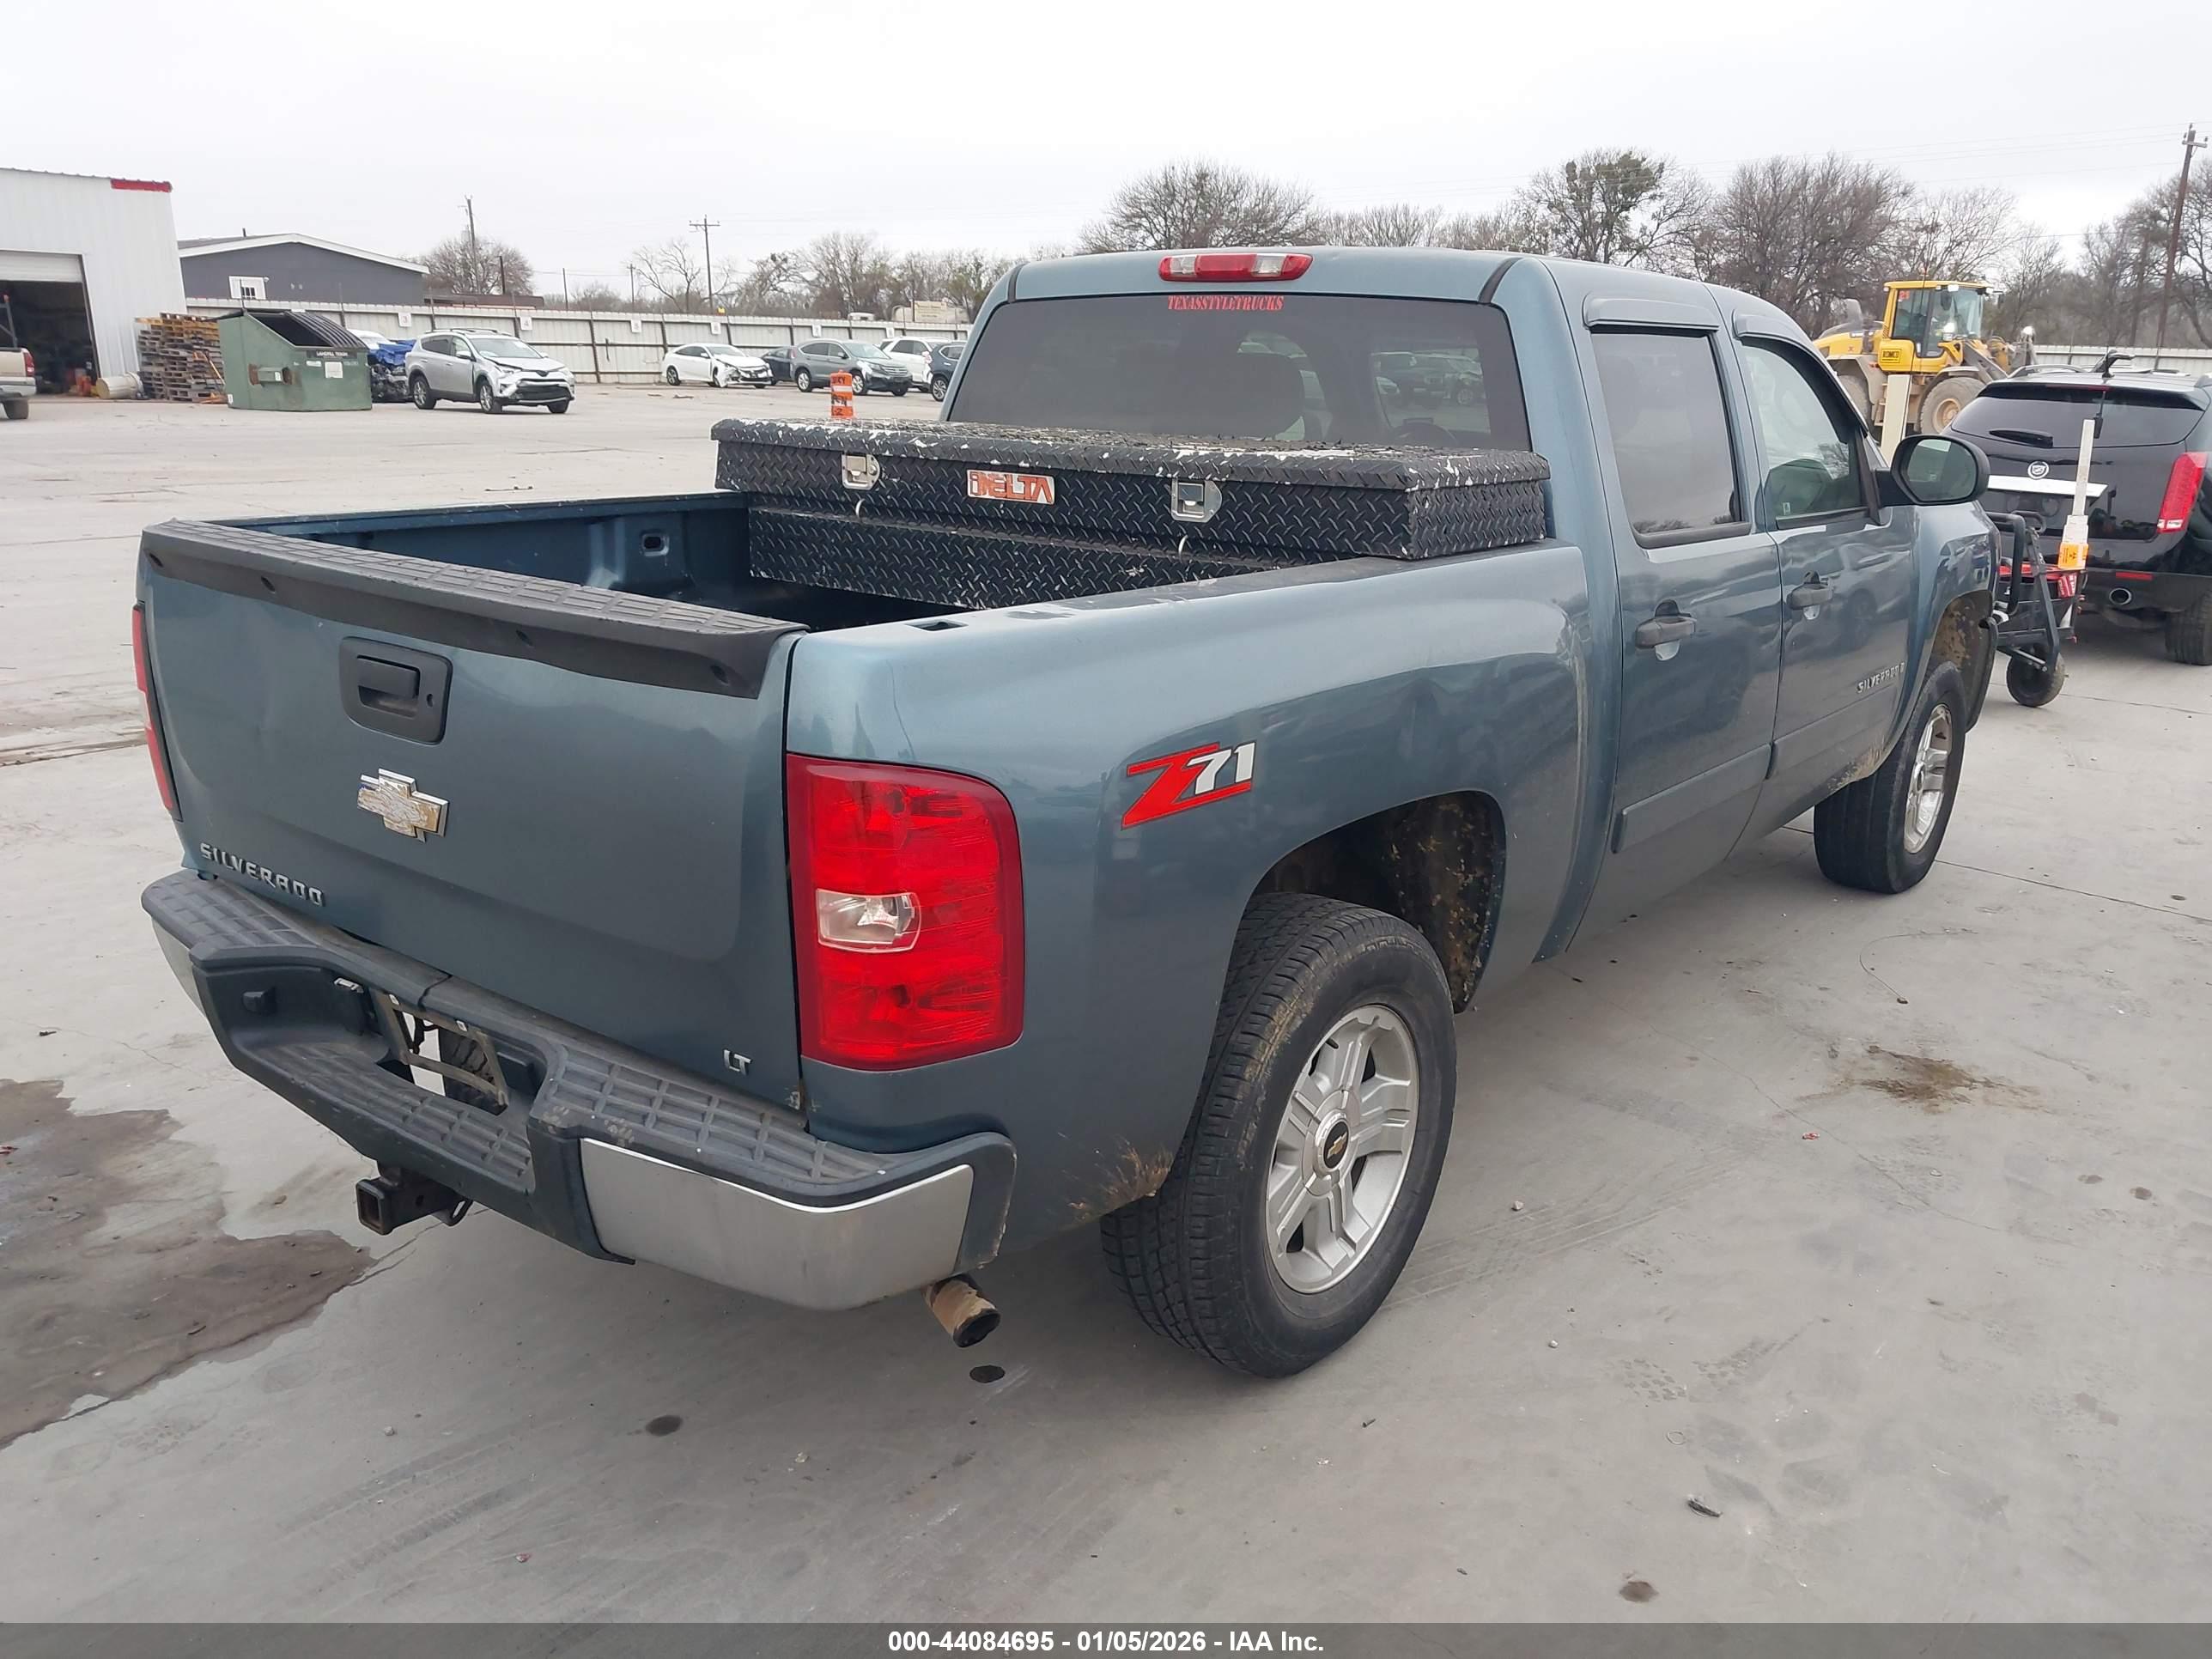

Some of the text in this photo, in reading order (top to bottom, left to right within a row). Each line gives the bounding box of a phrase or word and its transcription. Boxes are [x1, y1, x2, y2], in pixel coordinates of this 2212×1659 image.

[1121, 741, 1257, 830] Z71
[199, 842, 325, 907] SILVERADO
[723, 1048, 752, 1076] LT
